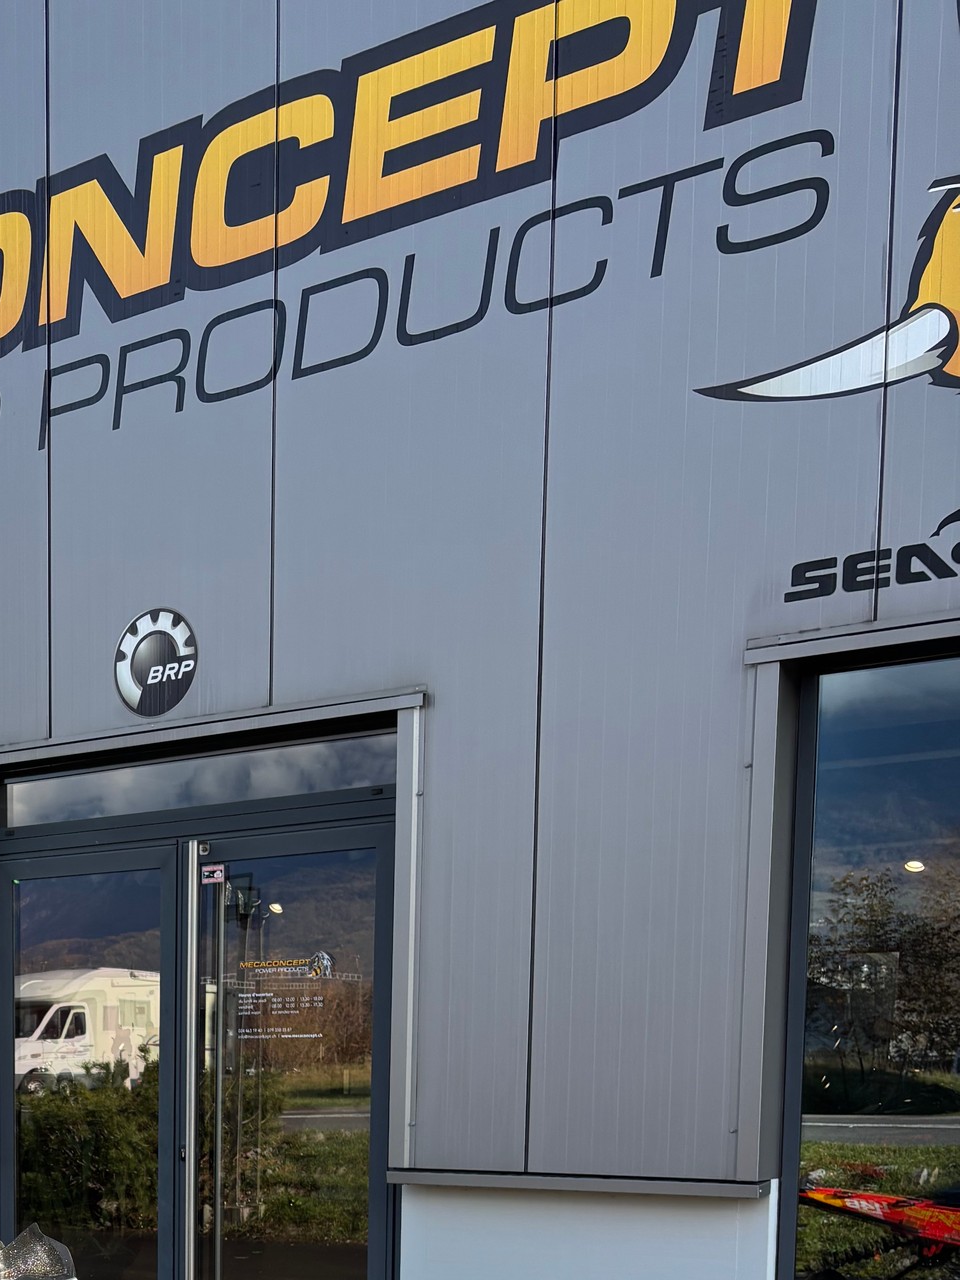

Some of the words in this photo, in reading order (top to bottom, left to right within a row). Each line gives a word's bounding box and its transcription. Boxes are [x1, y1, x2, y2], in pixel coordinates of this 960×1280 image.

[38, 129, 835, 450] PRODUCTS
[146, 659, 195, 685] BRP
[239, 958, 311, 969] MECACONCEPT
